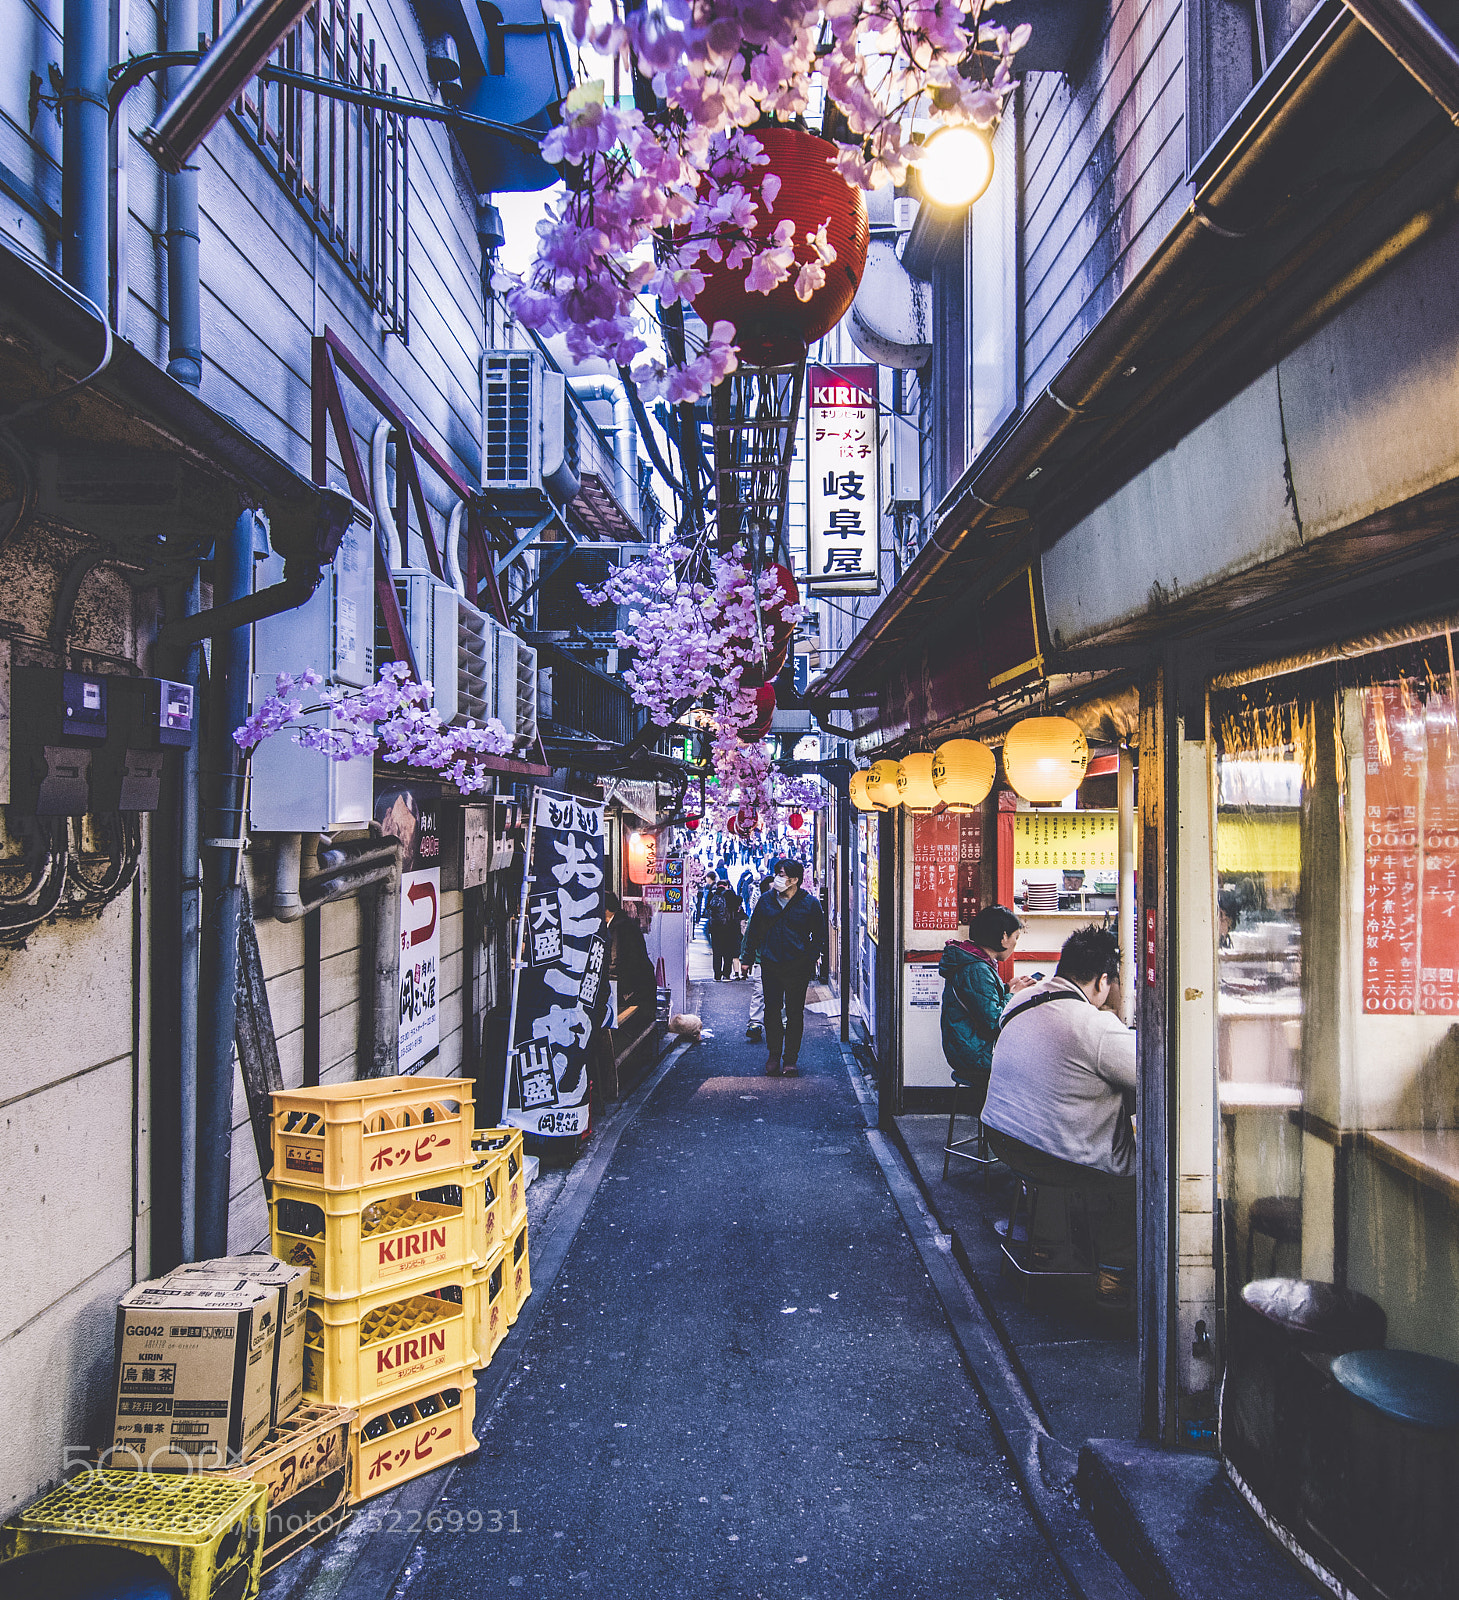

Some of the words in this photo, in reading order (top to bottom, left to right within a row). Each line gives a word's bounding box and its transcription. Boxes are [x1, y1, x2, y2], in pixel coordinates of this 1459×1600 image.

[813, 386, 873, 404] KIRIN
[815, 428, 866, 441] ラーメン
[823, 470, 866, 574] 岐阜屋
[420, 811, 437, 831] 肉めし
[549, 803, 598, 834] もりもり
[1368, 805, 1382, 846] 四七〇
[1400, 805, 1416, 846] 四二〇
[1428, 806, 1443, 848] 三六〇
[938, 865, 946, 886] ビール
[948, 865, 956, 894] 黒ビール
[1426, 856, 1442, 900] 餃子
[1442, 855, 1457, 918] シューマイ
[1366, 855, 1380, 949] ザーサイ・冷奴
[1382, 855, 1397, 942] 牛モツ煮込み
[530, 897, 562, 962] 大盛
[579, 939, 605, 1004] 特盛
[1382, 969, 1396, 1010] 三六〇
[1439, 968, 1454, 1010] 四二〇
[519, 1043, 556, 1107] 山盛
[287, 1148, 321, 1159] ホッピー
[370, 1133, 451, 1172] ホッピー
[378, 1226, 446, 1264] KIRIN
[399, 1259, 426, 1272] キリンビール
[126, 1326, 164, 1336] GG042
[376, 1328, 445, 1373] KIRIN
[124, 1367, 174, 1382] 烏龍茶
[138, 1353, 163, 1361] KIRIN
[397, 1363, 425, 1379] キリンビール
[368, 1427, 452, 1481] ホッピー
